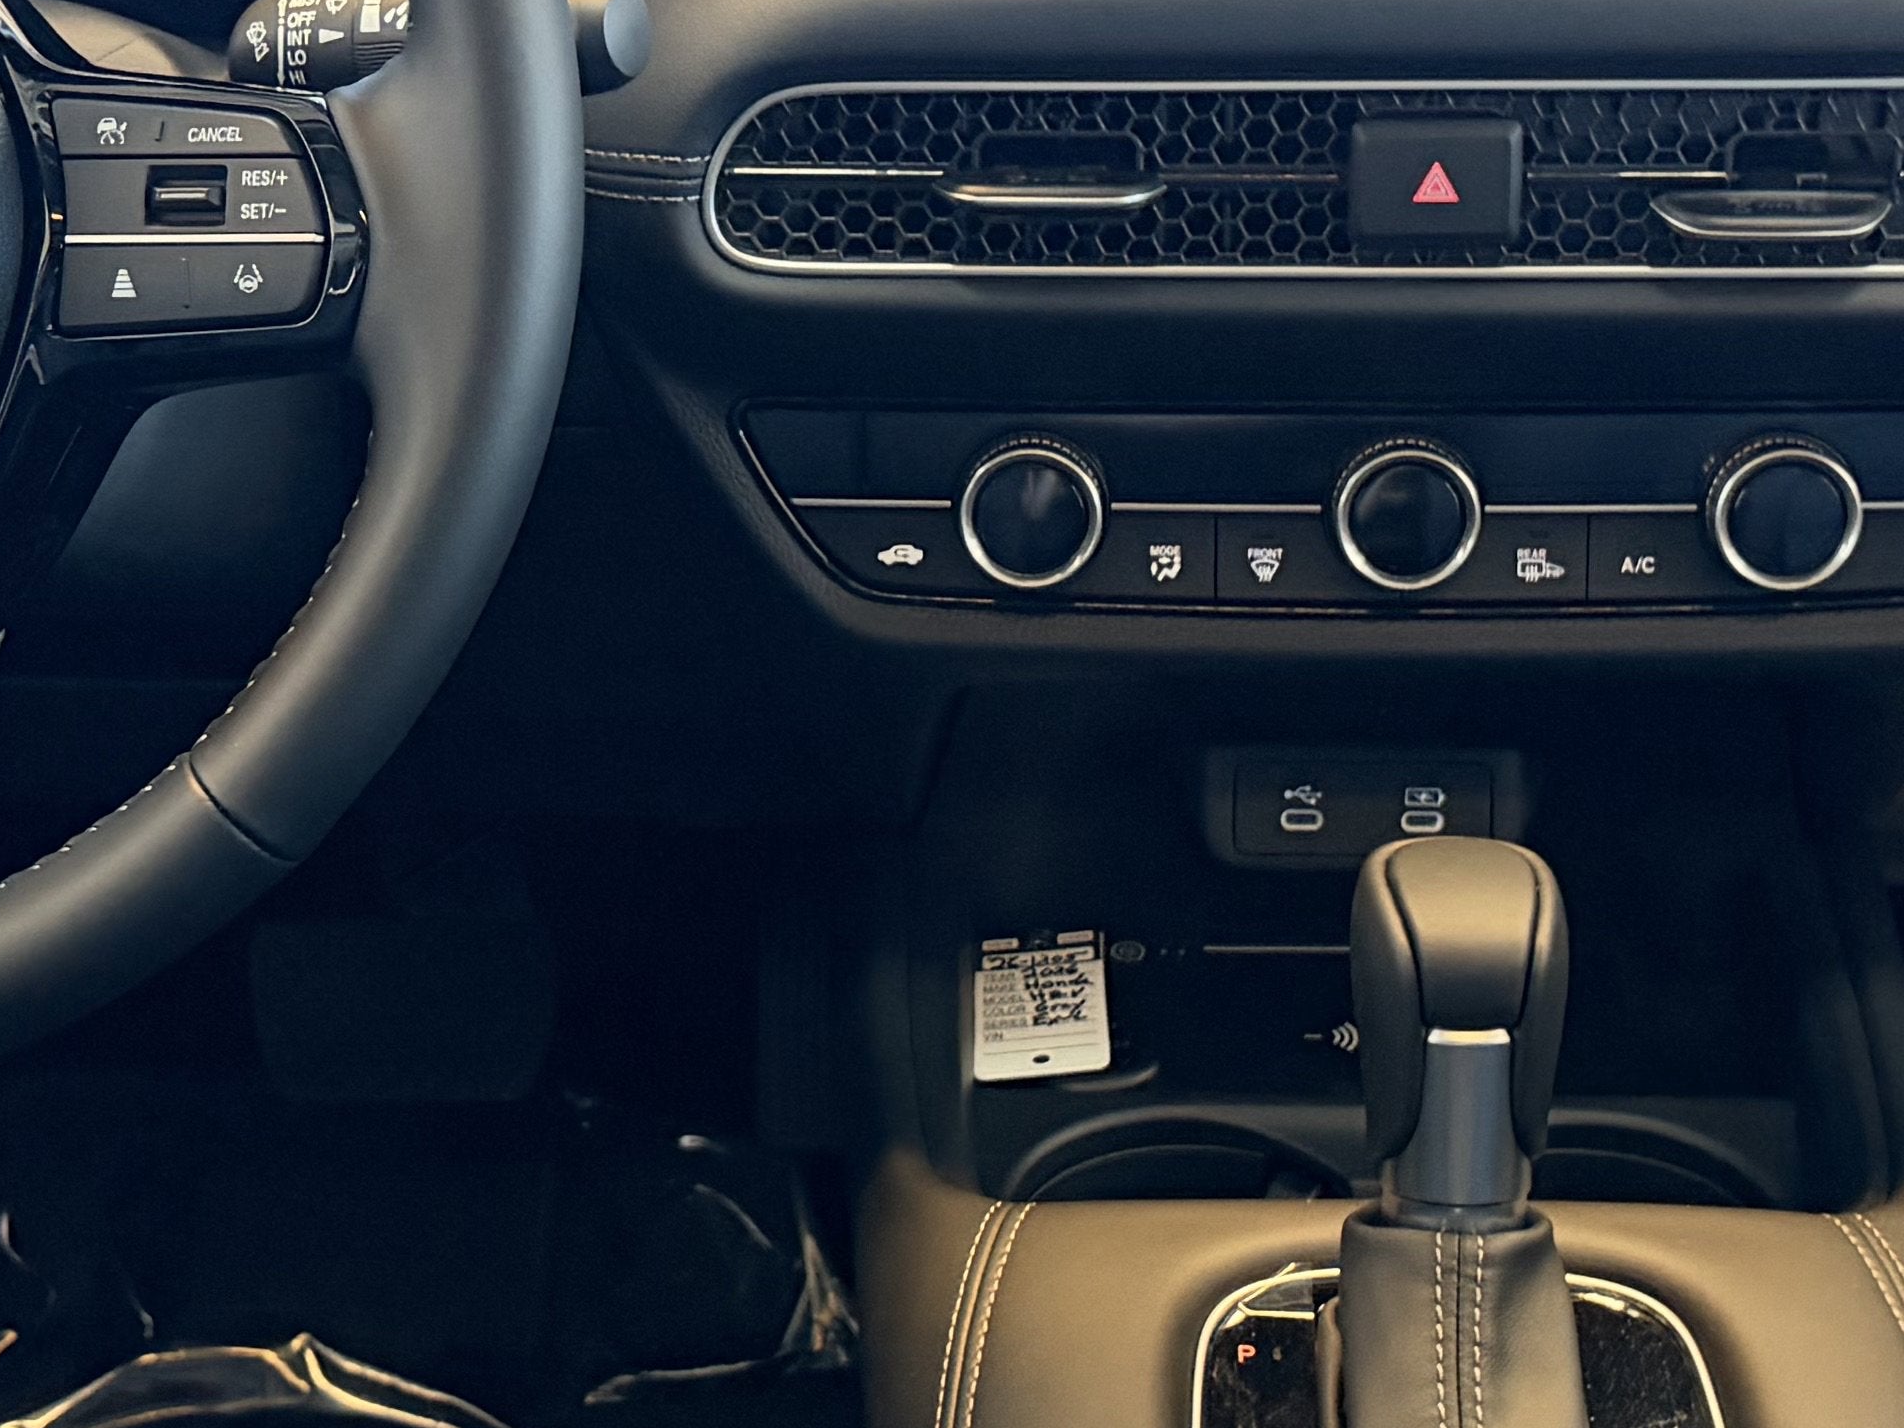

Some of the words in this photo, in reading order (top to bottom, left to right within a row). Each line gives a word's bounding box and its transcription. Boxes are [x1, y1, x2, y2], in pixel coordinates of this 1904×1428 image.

[287, 11, 316, 28] OFF
[287, 29, 312, 45] INT
[287, 49, 306, 66] LO
[187, 126, 243, 143] CANCEL
[241, 170, 289, 187] RES/+
[1149, 544, 1181, 556] MODE
[1247, 547, 1283, 561] FRONT
[1516, 548, 1547, 560] REAR
[1621, 556, 1655, 574] A/C
[1237, 1344, 1256, 1363] P
